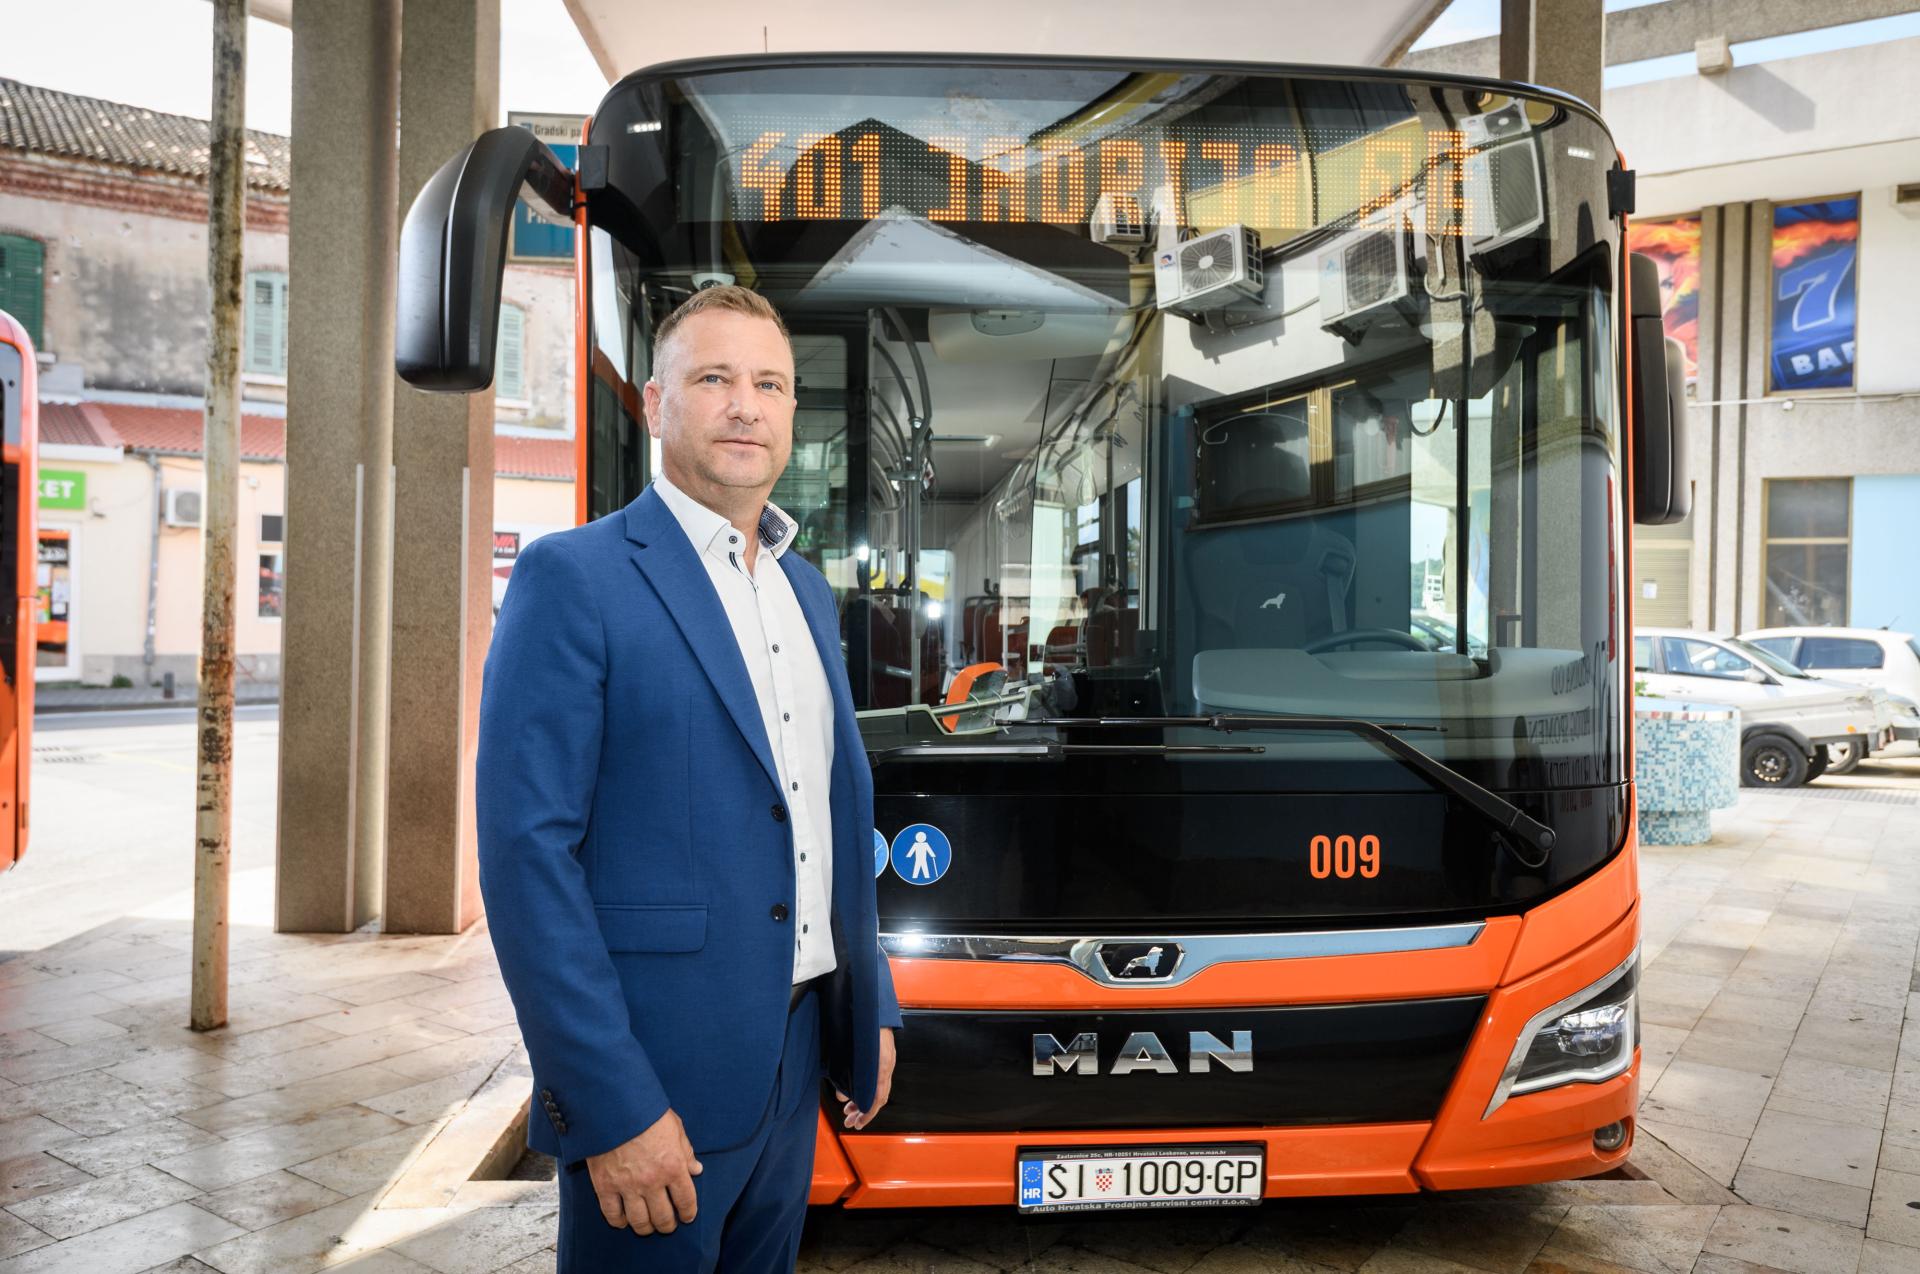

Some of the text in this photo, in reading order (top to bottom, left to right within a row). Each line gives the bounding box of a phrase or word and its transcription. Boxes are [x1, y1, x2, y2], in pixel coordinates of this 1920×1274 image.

[534, 124, 568, 137] Gradski
[741, 131, 880, 221] 401
[1309, 834, 1381, 880] 009
[1032, 1030, 1254, 1076] MAN
[1023, 1187, 1041, 1200] HR
[1048, 1163, 1084, 1199] ŠI
[1032, 1197, 1249, 1213] Auto Hrvatska Prodajno servisni centri d.o.o.
